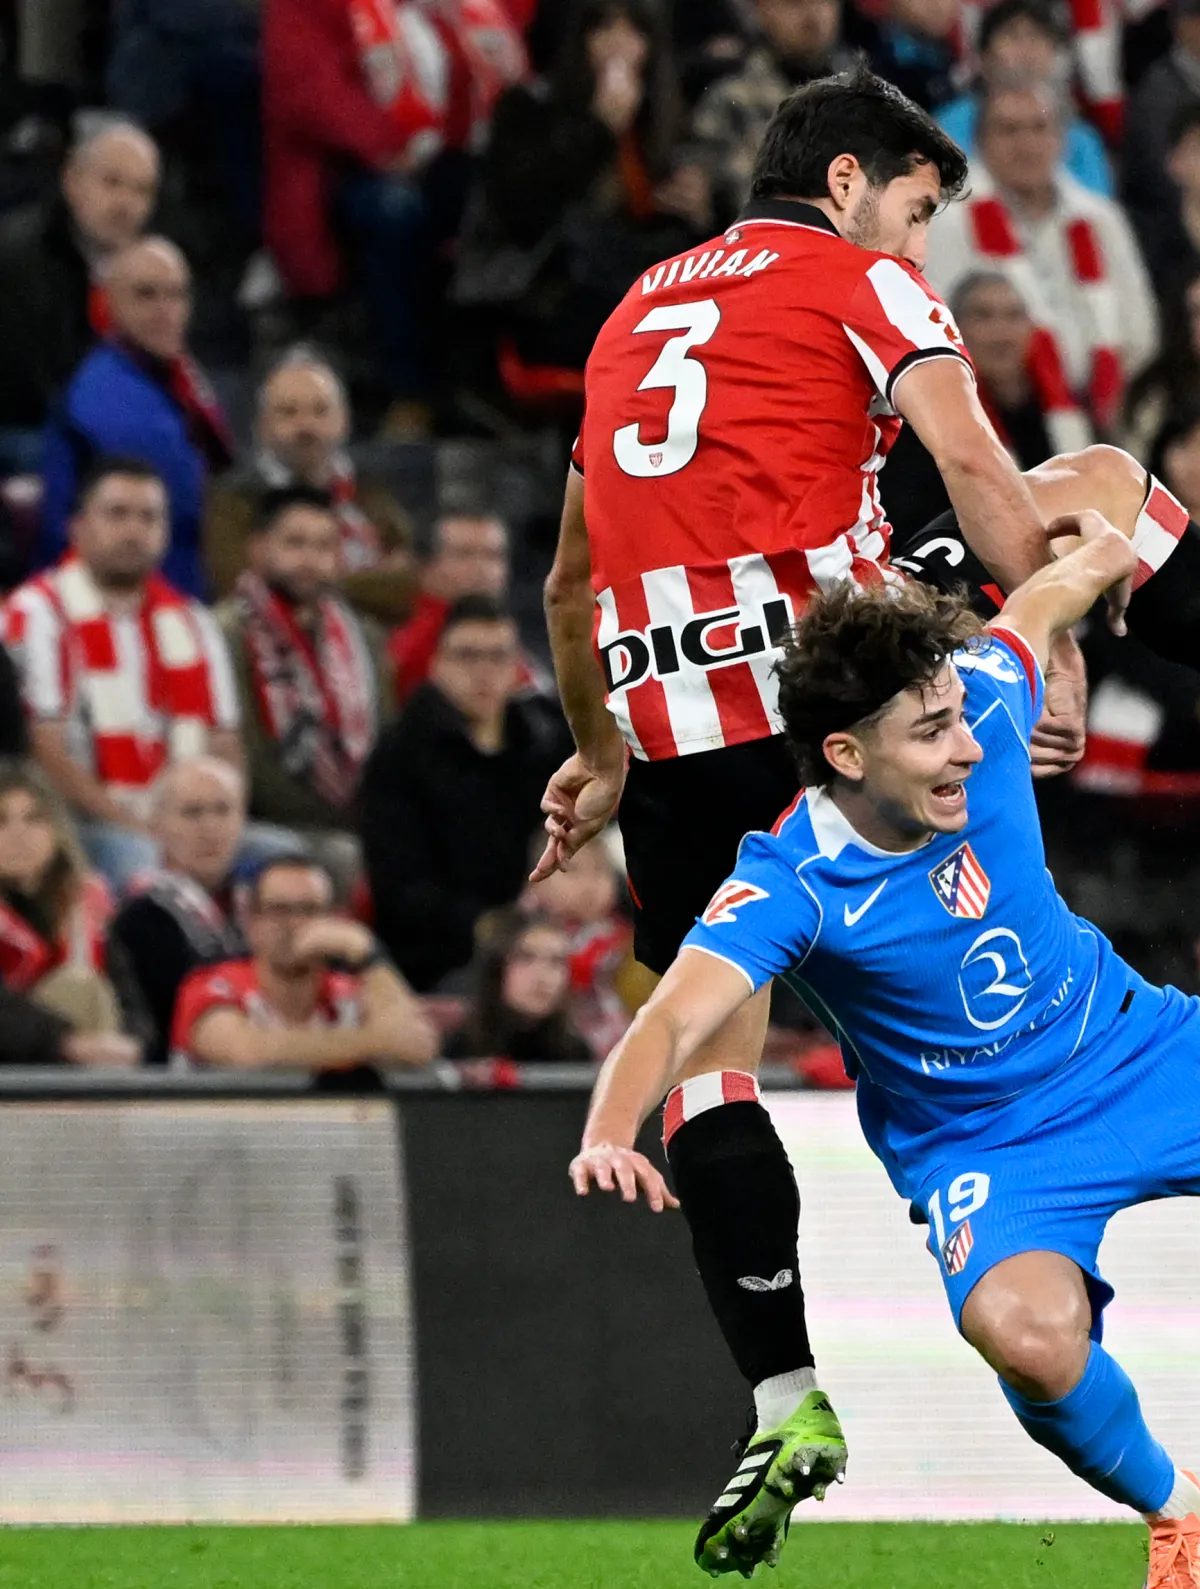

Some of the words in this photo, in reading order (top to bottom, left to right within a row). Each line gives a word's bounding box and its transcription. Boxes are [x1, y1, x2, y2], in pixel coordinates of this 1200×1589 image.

[641, 249, 780, 295] VIVIAN
[612, 298, 721, 478] 3
[600, 598, 790, 692] DIGI
[927, 1171, 991, 1252] 19
